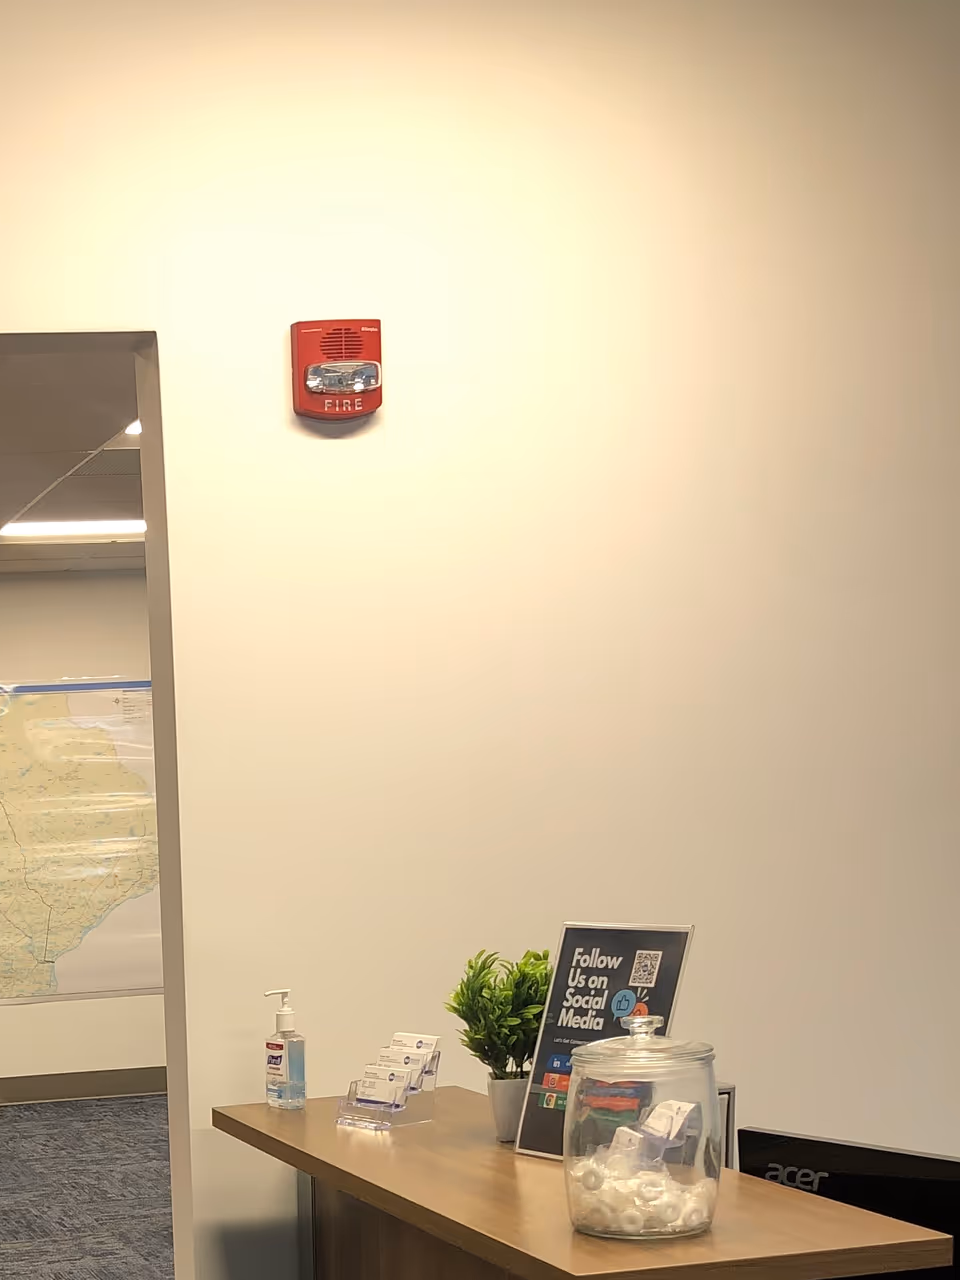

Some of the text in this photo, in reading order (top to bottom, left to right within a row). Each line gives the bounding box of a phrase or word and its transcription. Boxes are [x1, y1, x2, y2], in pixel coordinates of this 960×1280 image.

[324, 398, 363, 412] FIRE
[572, 948, 623, 970] Follow
[567, 968, 608, 989] Us on
[562, 988, 609, 1010] Social
[557, 1008, 605, 1031] Media
[764, 1162, 829, 1192] acer
